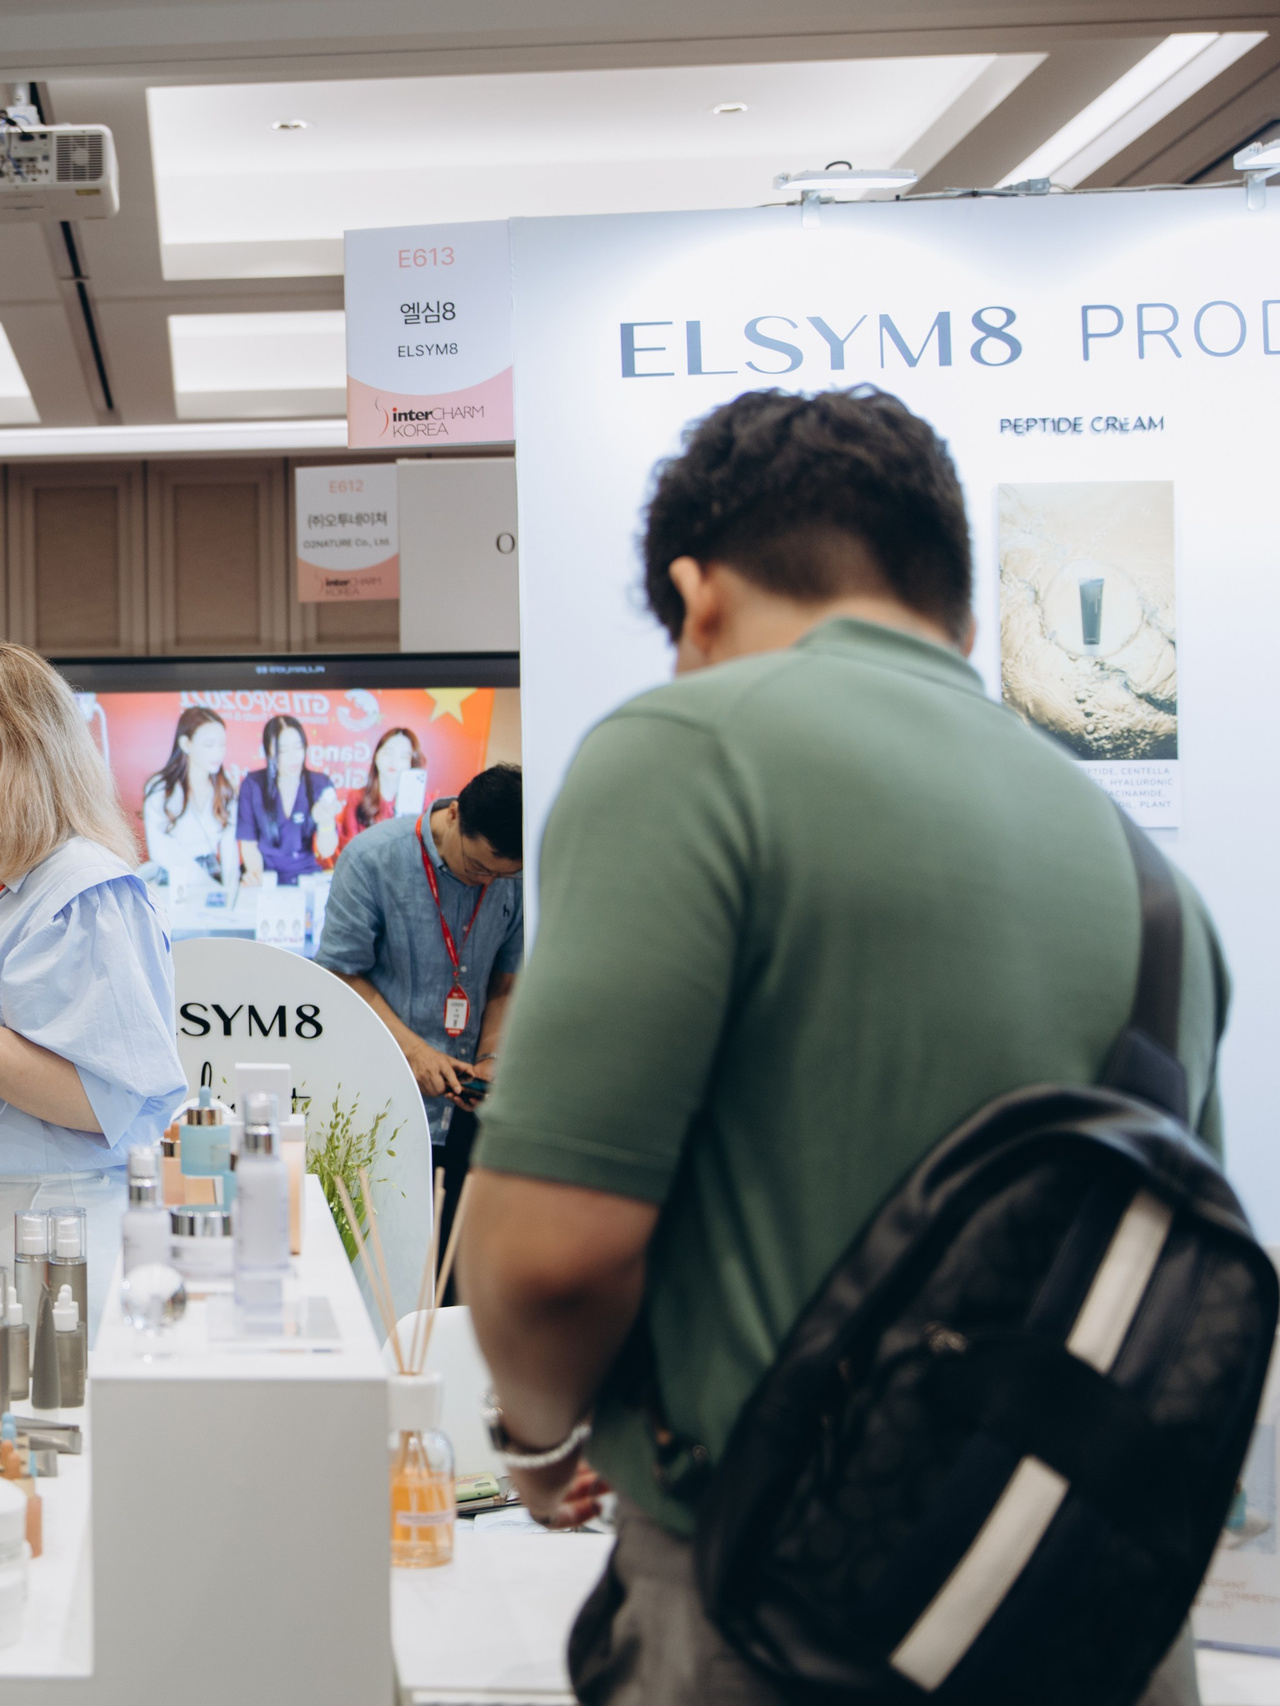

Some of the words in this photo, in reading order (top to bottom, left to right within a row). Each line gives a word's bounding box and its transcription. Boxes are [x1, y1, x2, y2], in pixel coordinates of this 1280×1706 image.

[397, 246, 456, 269] E613
[399, 300, 457, 325] 엘심8
[397, 342, 459, 358] ELSYM8
[619, 305, 1022, 378] ELSYM8
[392, 405, 485, 423] interCHARM
[392, 423, 450, 438] KOREA
[999, 416, 1084, 434] PEPTIDE
[1091, 415, 1165, 432] CREAM
[328, 479, 364, 494] E612
[1080, 767, 1118, 776] EPTIDE,
[176, 1002, 323, 1039] SYM8
